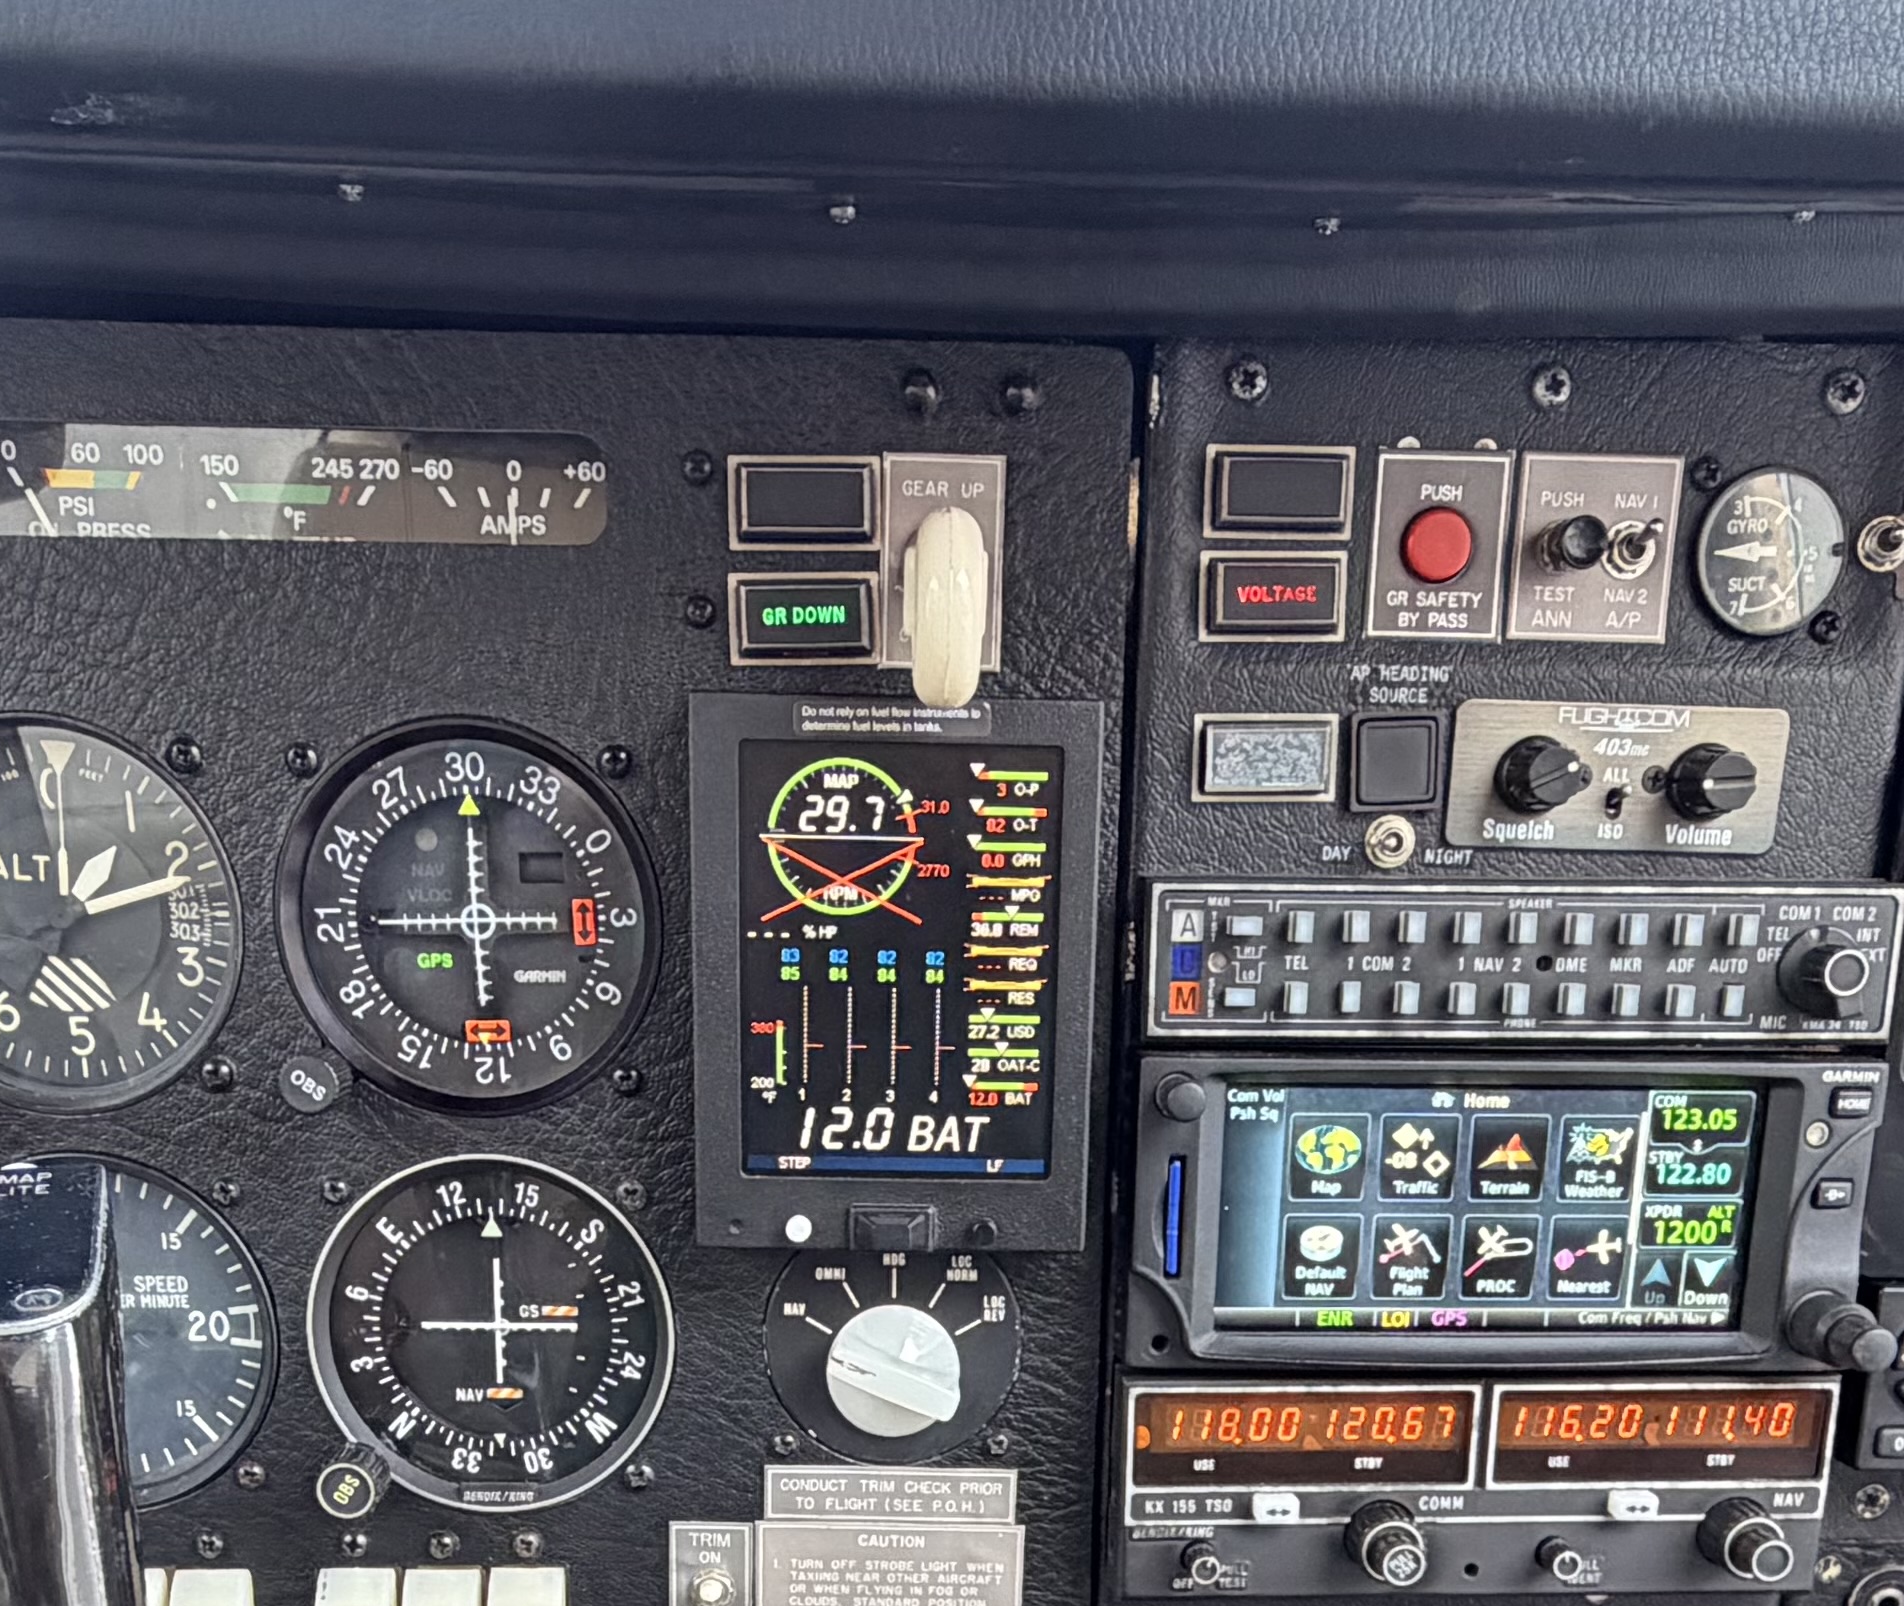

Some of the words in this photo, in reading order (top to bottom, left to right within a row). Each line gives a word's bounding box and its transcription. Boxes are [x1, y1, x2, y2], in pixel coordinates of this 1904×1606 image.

[200, 455, 239, 476] 150
[312, 457, 354, 478] 245
[359, 459, 400, 479] 270
[902, 480, 949, 497] GEAR
[961, 482, 985, 498] UP
[1420, 485, 1463, 501] PUSH
[58, 497, 95, 517] PSI
[1541, 491, 1584, 507] PUSH
[1615, 494, 1647, 508] NAV
[480, 515, 547, 535] AMPS
[1727, 519, 1768, 535] GYRO
[1728, 577, 1765, 593] SUCT
[1237, 586, 1317, 603] VOLTAGE
[1387, 591, 1408, 606] GR
[1416, 592, 1482, 608] SAFETY
[1534, 587, 1574, 601] TEST
[1604, 589, 1636, 603] NAV
[1638, 590, 1648, 604] 2
[762, 607, 787, 626] GR
[792, 605, 846, 624] DOWN
[1398, 613, 1418, 627] BY
[1428, 613, 1468, 628] PASS
[1532, 611, 1572, 628] ANN
[1605, 611, 1641, 629] A/P
[1351, 666, 1370, 681] AP
[1380, 666, 1449, 682] HEADING
[1369, 688, 1428, 703] SOURCE
[445, 752, 485, 782] 30
[823, 774, 859, 789] MAP
[1602, 768, 1630, 784] ALL
[798, 795, 885, 832] 29.7
[1483, 819, 1555, 841] Squelch
[1598, 823, 1624, 840] ISO
[1665, 824, 1732, 846] Volume
[1322, 846, 1352, 863] DAY
[1424, 848, 1473, 867] NIGHT
[918, 864, 950, 877] 2770
[417, 953, 454, 969] GPS
[1284, 955, 1309, 972] TEL
[1362, 955, 1395, 972] COM
[1474, 956, 1504, 972] NAV
[1555, 956, 1588, 973] DME
[1610, 956, 1642, 973] MKR
[1667, 956, 1695, 974] ADF
[1708, 957, 1748, 974] AUTO
[513, 969, 566, 983] GARMIN
[290, 1069, 327, 1101] OBS
[1822, 1070, 1880, 1084] GARMIN
[1464, 1092, 1510, 1109] Home
[1660, 1108, 1737, 1131] 123.05
[800, 1106, 894, 1150] 12.0
[908, 1116, 990, 1152] BAT
[0, 1172, 52, 1185] MAP
[1655, 1162, 1732, 1186] 122.80
[1393, 1179, 1438, 1196] Traffic
[1480, 1180, 1530, 1196] Terrain
[1654, 1219, 1717, 1245] 1200
[134, 1276, 189, 1294] SPEED
[1477, 1278, 1515, 1295] PROC
[1557, 1279, 1610, 1295] Nearest
[1317, 1310, 1354, 1328] ENR
[1431, 1309, 1467, 1328] GPS
[1170, 1407, 1301, 1443] 118.00
[1326, 1406, 1456, 1444] 120.67
[1513, 1403, 1642, 1441] 116.20
[1664, 1402, 1794, 1441] 111.40
[780, 1479, 848, 1493] CONDUCT
[860, 1480, 895, 1493] TRIM
[904, 1481, 951, 1495] CHECK
[960, 1481, 1002, 1495] PRIOR
[795, 1496, 815, 1510] TO
[825, 1497, 876, 1511] FLIGHT
[885, 1498, 923, 1512] (SEE
[1144, 1498, 1166, 1514] KX
[1171, 1499, 1198, 1514] 155
[1203, 1499, 1233, 1514] TSO
[1418, 1495, 1465, 1511] COMM
[1773, 1492, 1804, 1507] NAV
[689, 1533, 731, 1547] TRIM
[858, 1534, 925, 1548] CAUTION
[699, 1551, 721, 1563] ON
